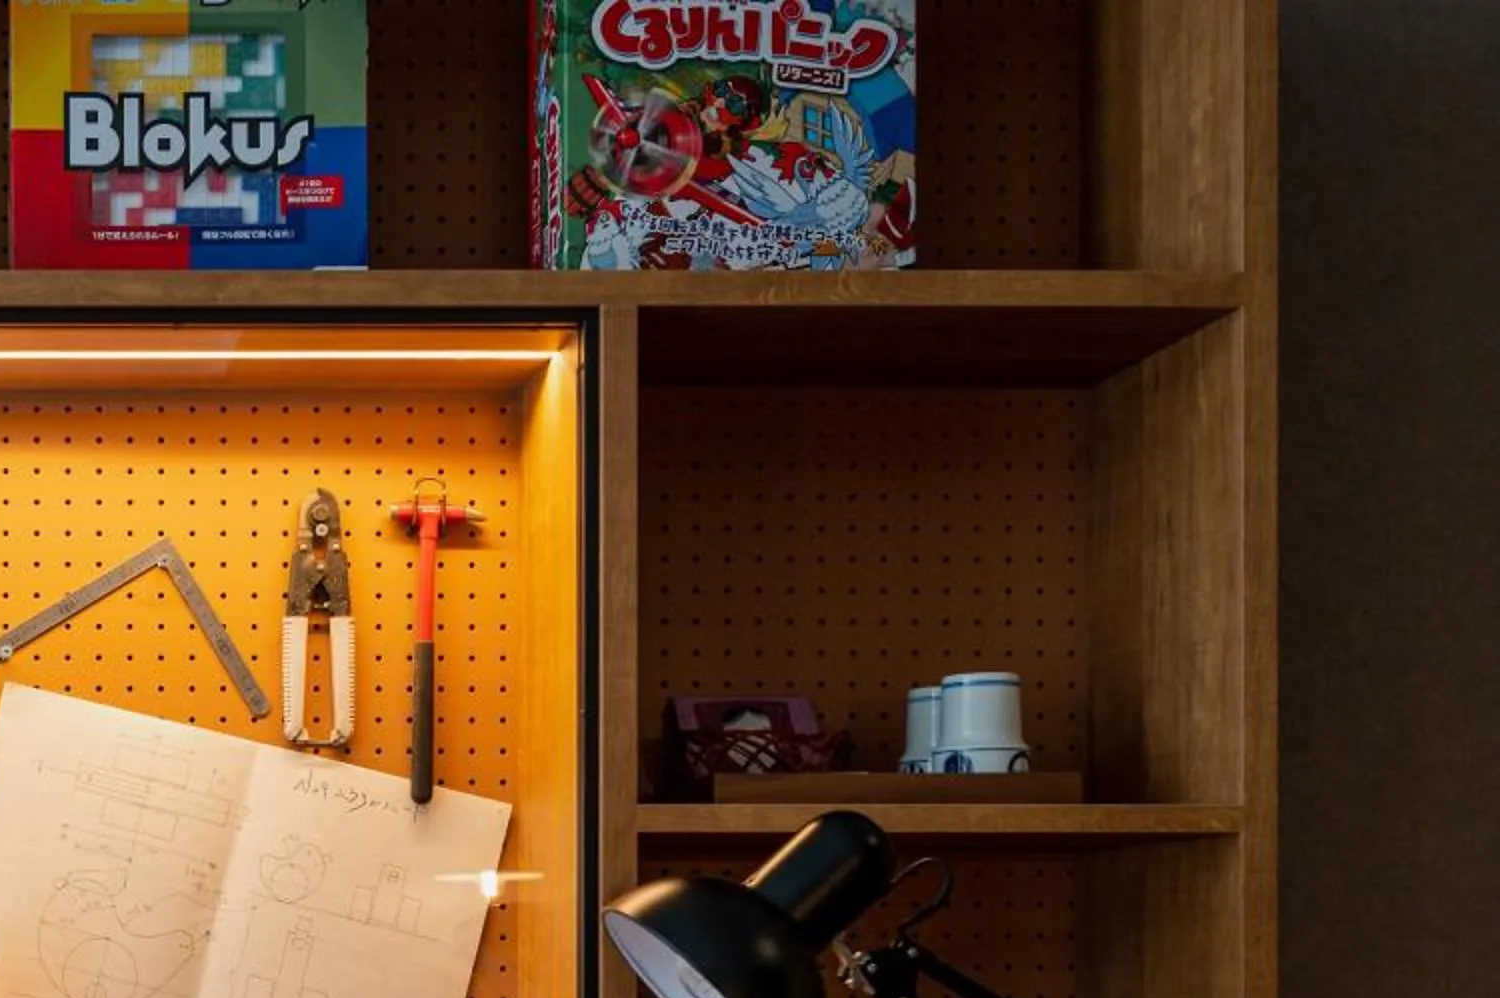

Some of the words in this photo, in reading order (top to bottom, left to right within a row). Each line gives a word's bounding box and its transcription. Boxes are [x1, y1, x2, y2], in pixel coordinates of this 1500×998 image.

[600, 0, 890, 68] くるりんパニック
[65, 92, 314, 190] Blokus
